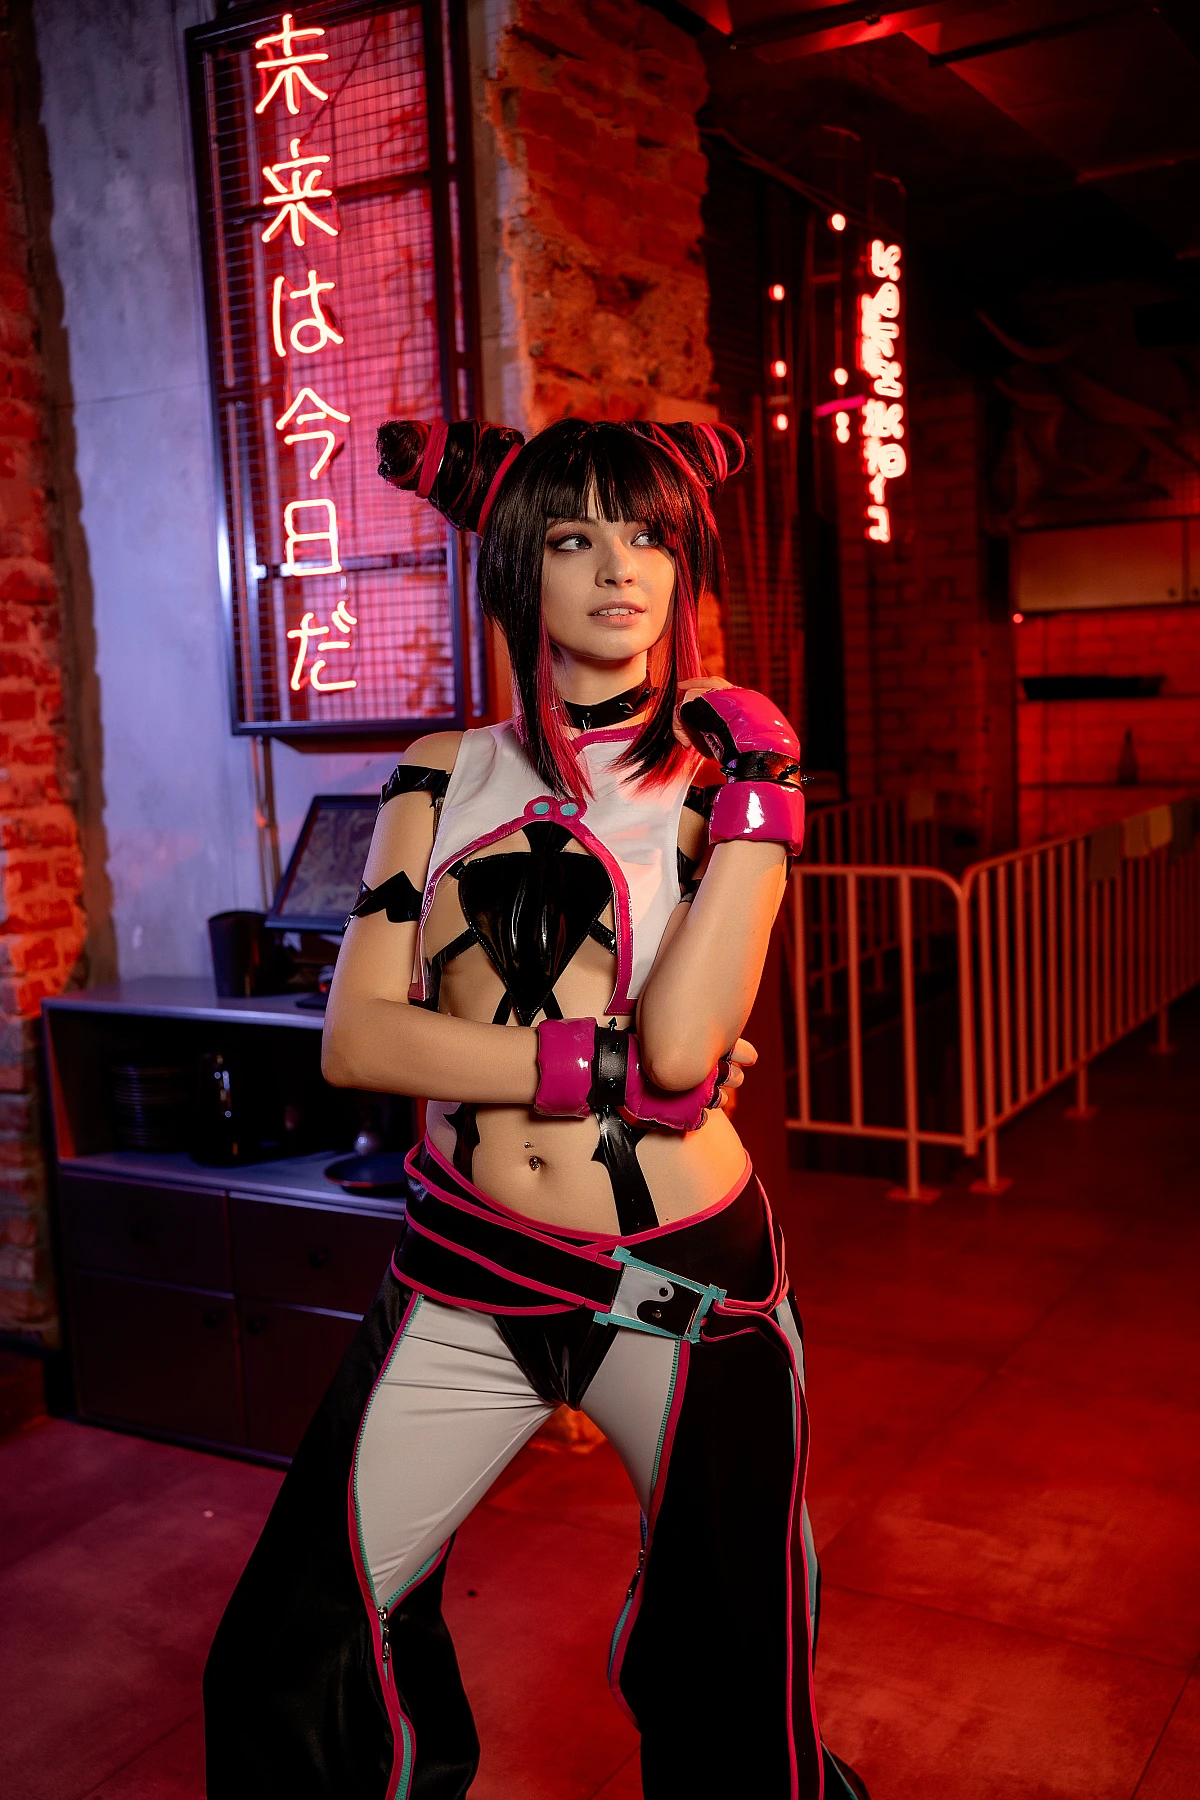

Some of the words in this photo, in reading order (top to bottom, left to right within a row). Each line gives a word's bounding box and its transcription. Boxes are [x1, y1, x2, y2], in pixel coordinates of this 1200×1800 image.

[254, 13, 358, 692] 未来は今日だ
